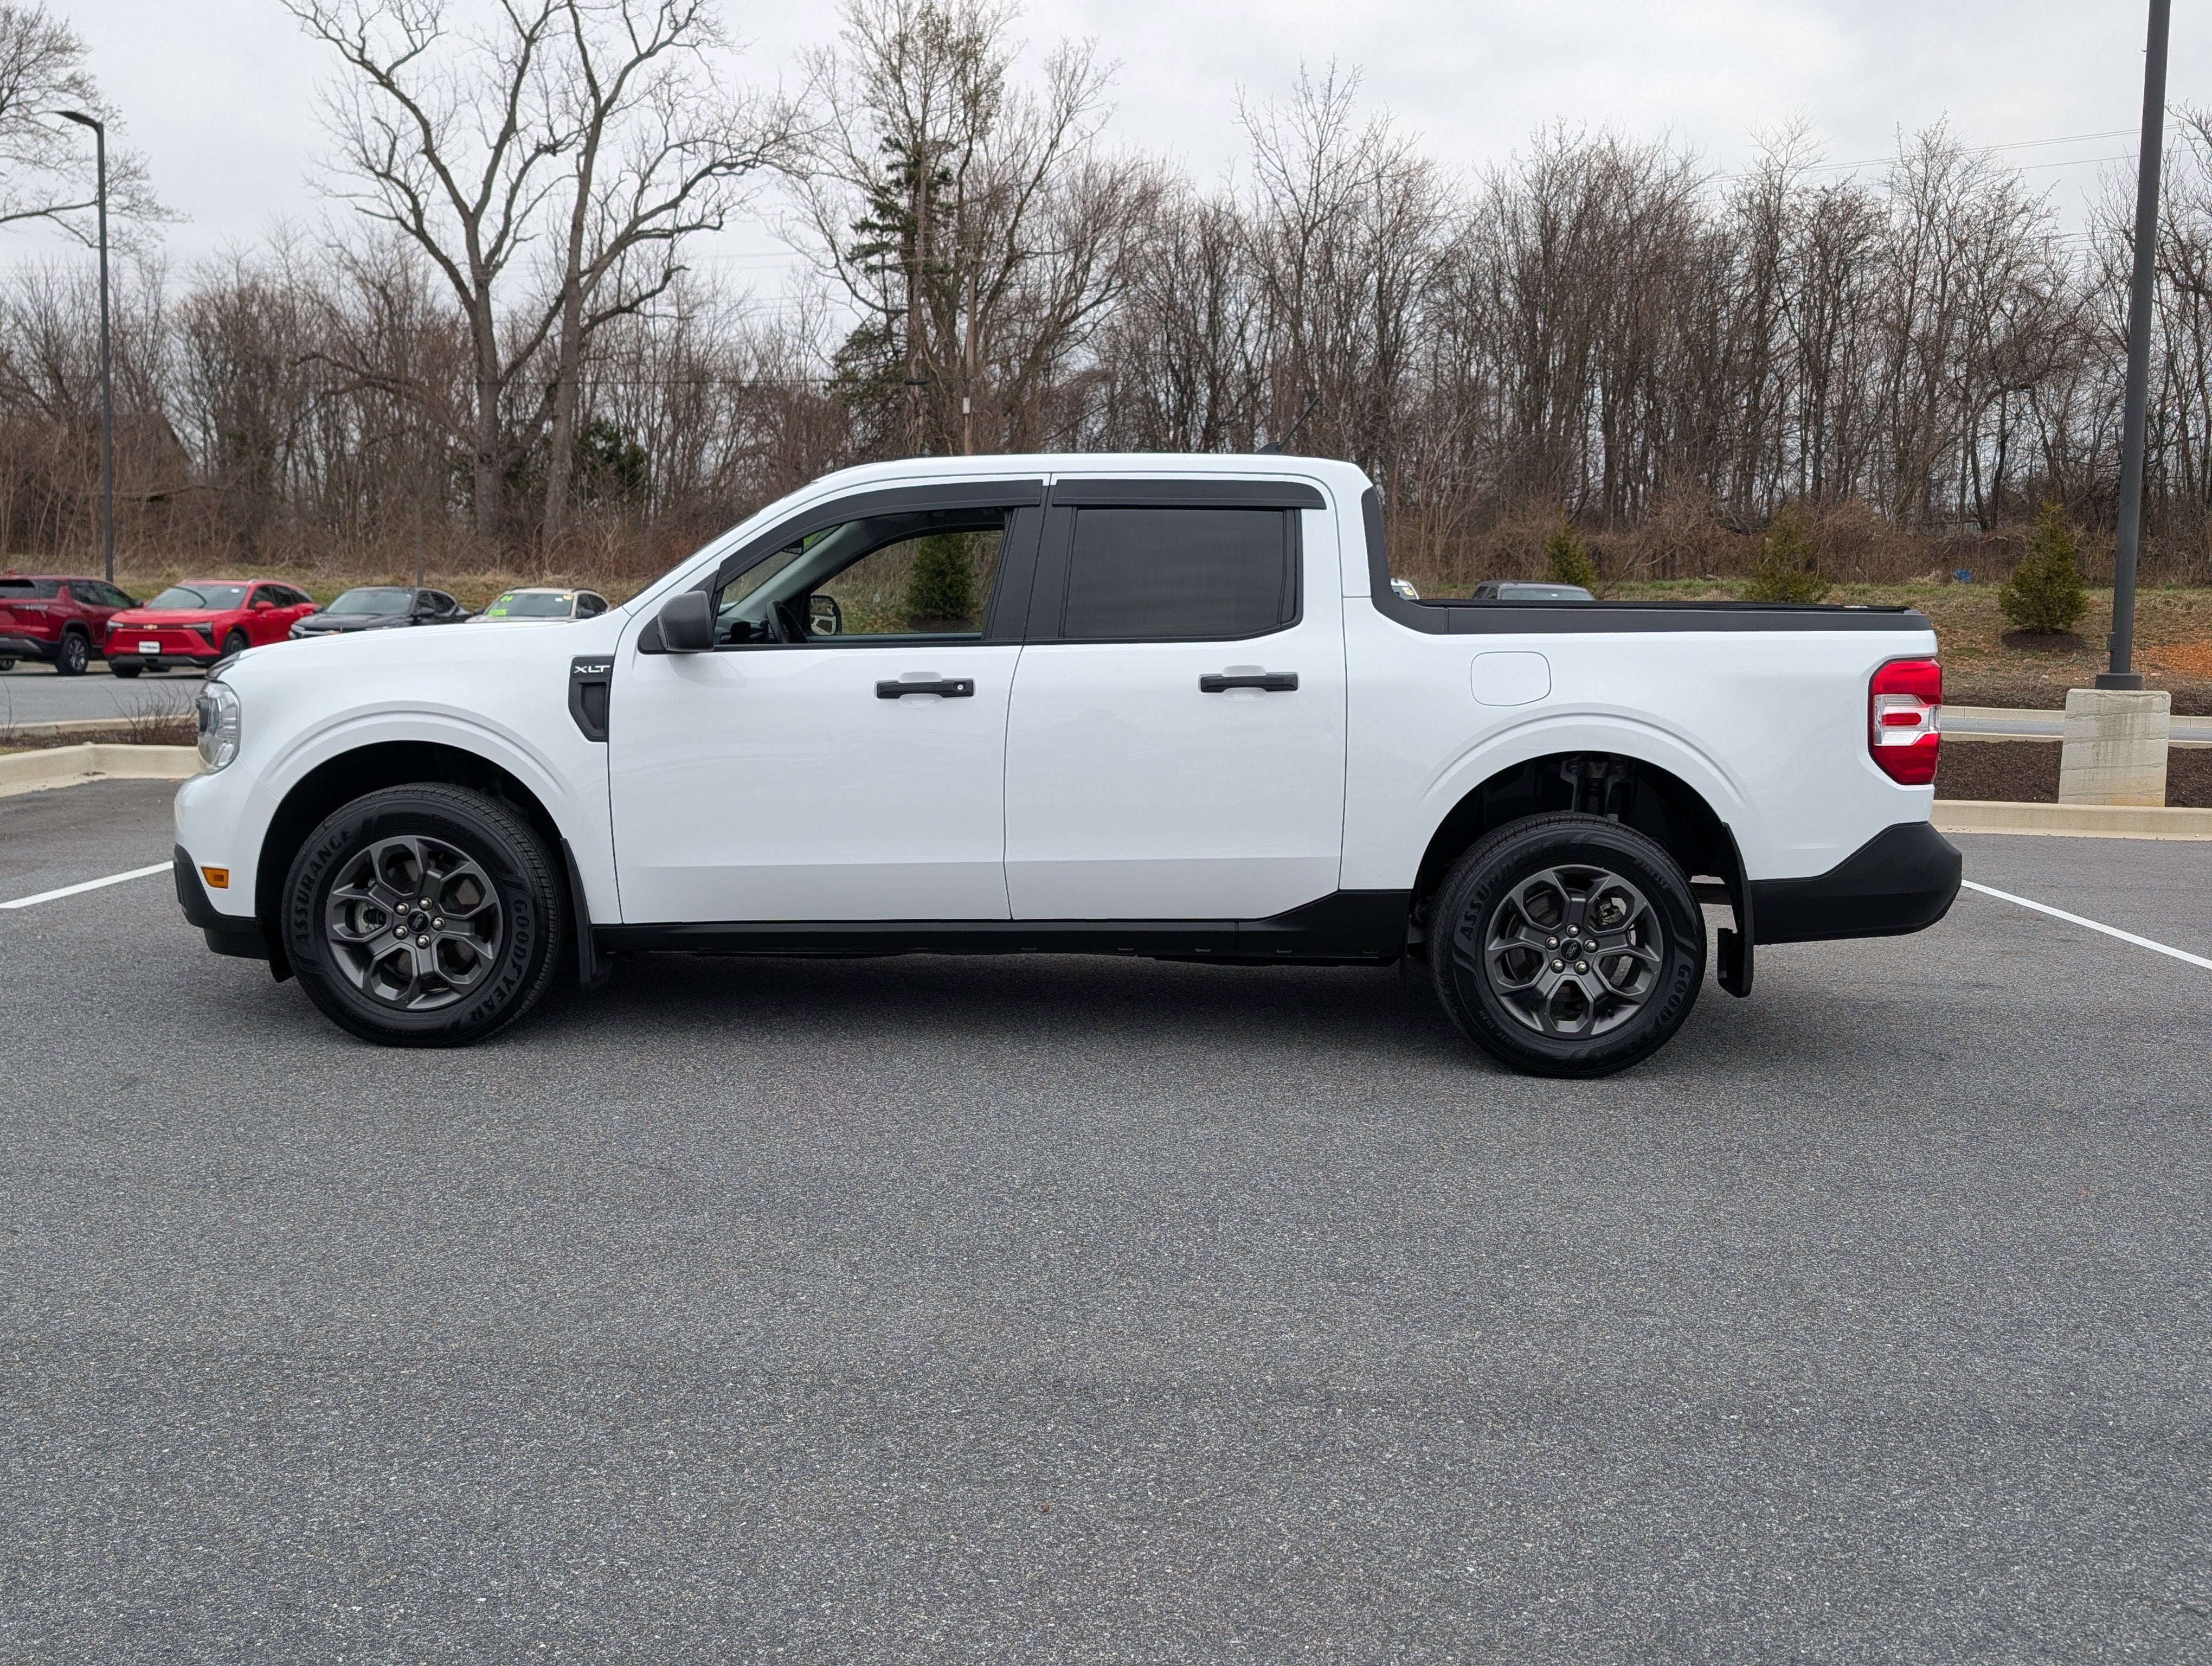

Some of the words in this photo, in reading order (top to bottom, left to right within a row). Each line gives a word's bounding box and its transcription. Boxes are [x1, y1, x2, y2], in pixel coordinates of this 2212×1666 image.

[574, 665, 610, 674] XLT
[292, 828, 351, 945] ASSURANCE
[1462, 841, 1554, 941] ASSURANCE
[469, 898, 528, 1022] GOODYEAR
[1594, 964, 1692, 1066] GOODYEAR
